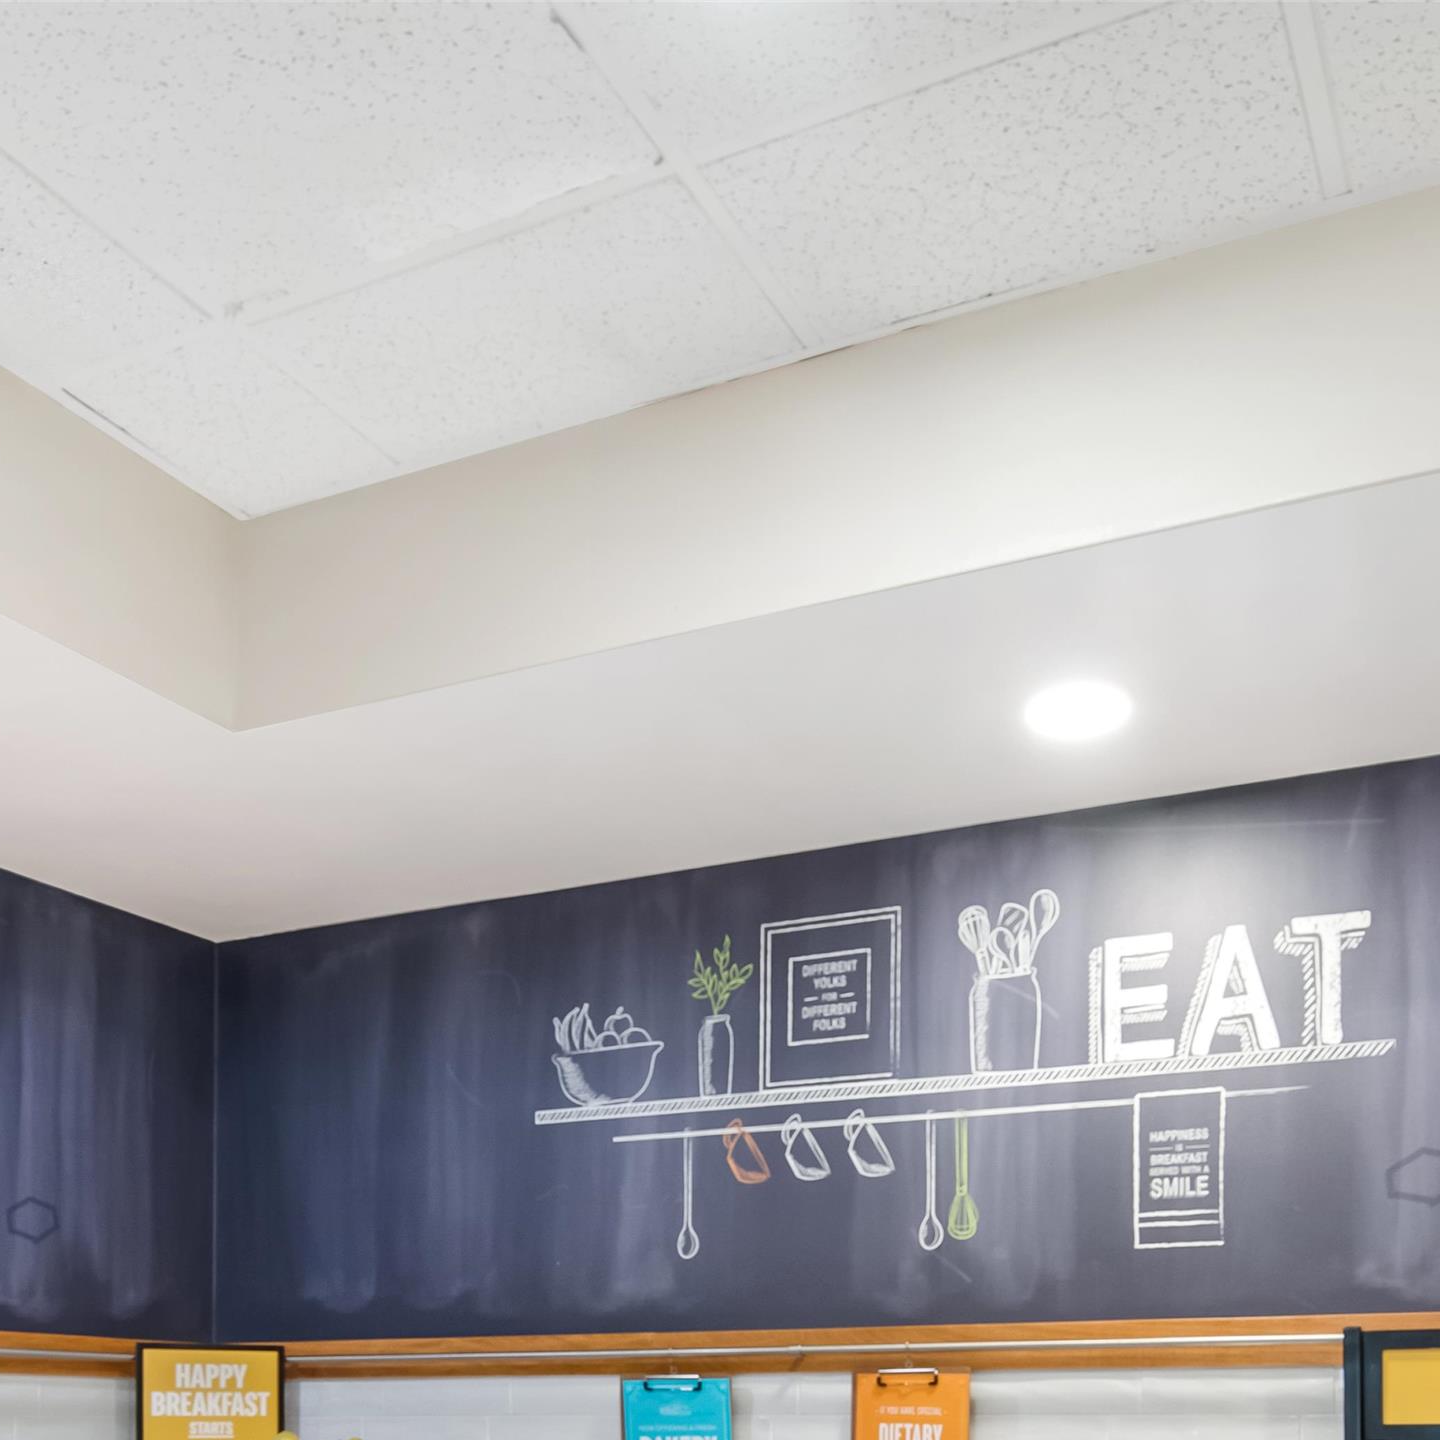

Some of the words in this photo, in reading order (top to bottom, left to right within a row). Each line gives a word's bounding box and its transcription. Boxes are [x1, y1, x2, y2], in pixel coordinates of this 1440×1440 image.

[802, 959, 858, 978] DIFFERENT
[813, 974, 848, 989] YOLKS
[1090, 909, 1372, 1064] EAT
[801, 1001, 858, 1019] DIFFERENT
[812, 1016, 847, 1032] FOLKS
[1149, 1127, 1210, 1143] HAPPINESS
[1149, 1151, 1209, 1167] BREAKFAST
[1149, 1175, 1210, 1199] SMILE
[175, 1363, 248, 1389] HAPPY
[150, 1391, 271, 1417] BREAKFAST
[188, 1421, 234, 1436] STARTS
